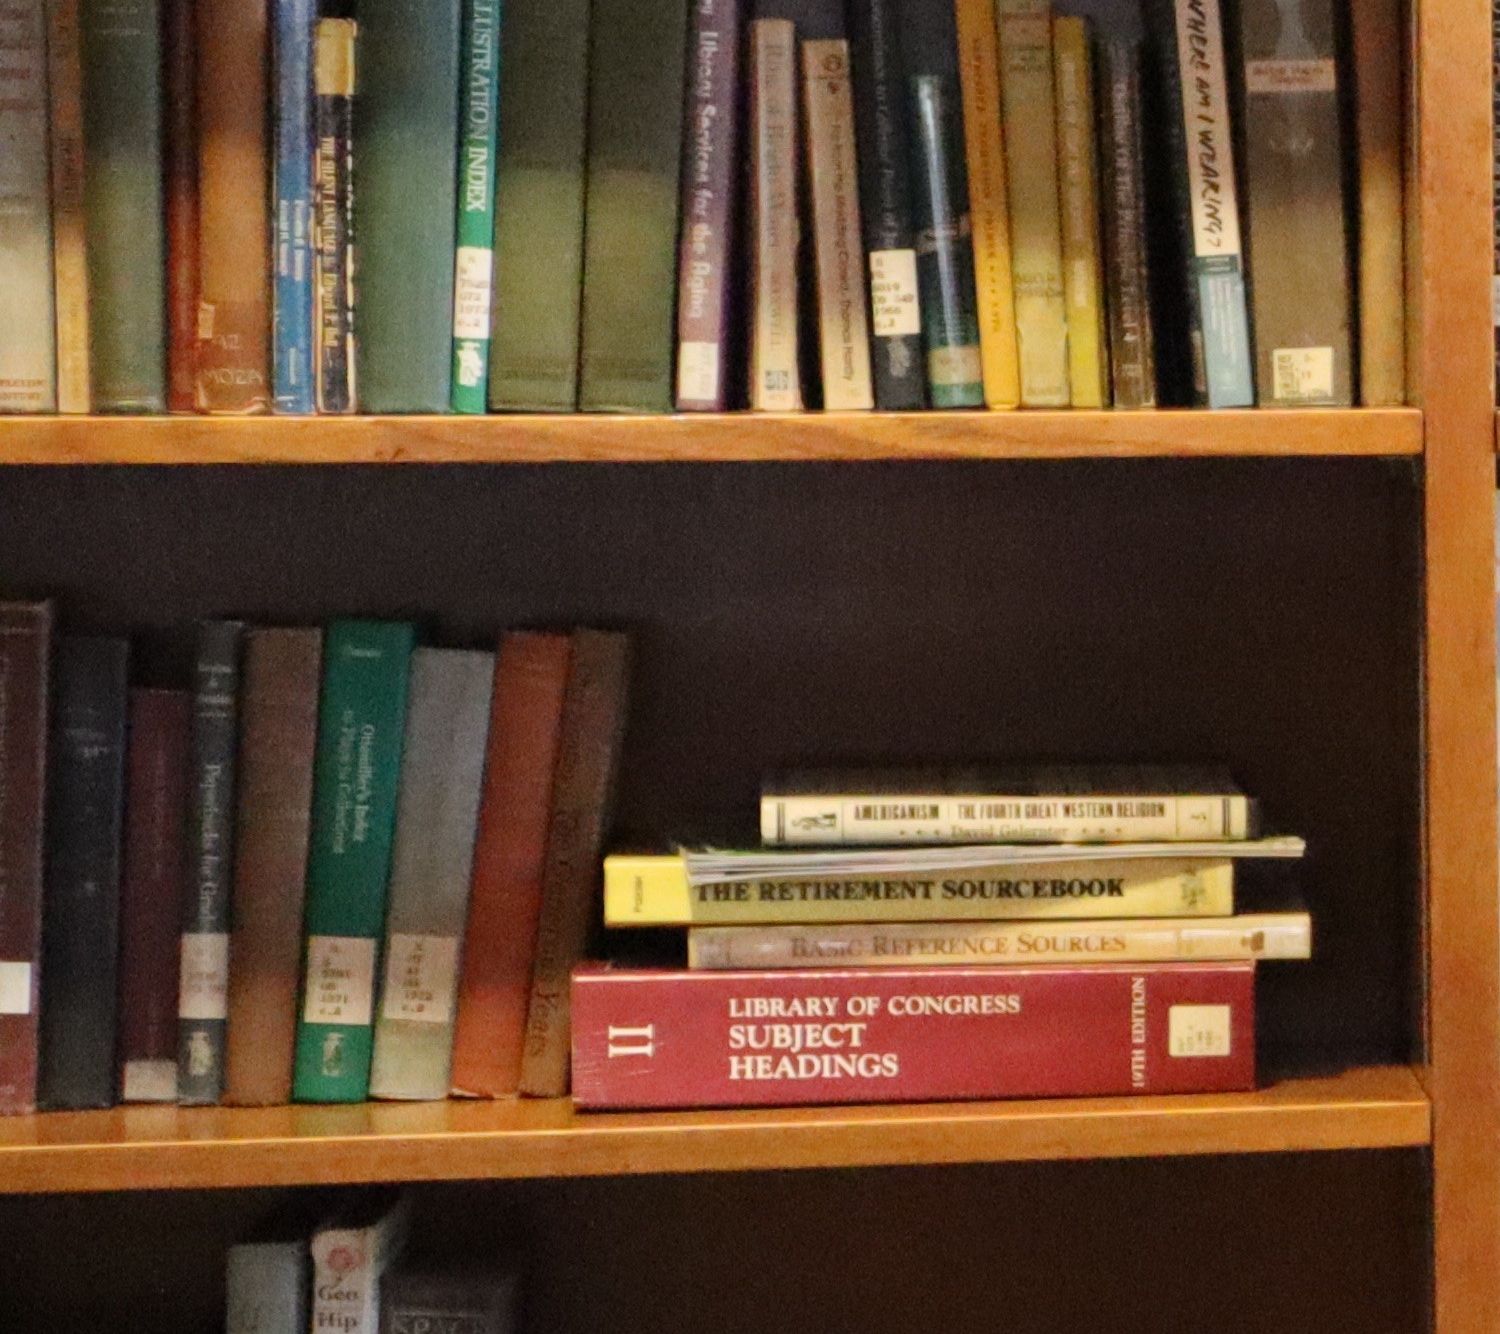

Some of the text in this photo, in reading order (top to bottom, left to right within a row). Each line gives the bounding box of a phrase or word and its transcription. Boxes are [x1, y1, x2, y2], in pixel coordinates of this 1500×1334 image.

[1195, 76, 1212, 109] AM
[694, 103, 717, 183] Services
[465, 145, 489, 213] INDEX
[1194, 127, 1223, 250] WEARING?
[854, 801, 1165, 821] AMERICANISM FOURTH GREAT WESTERN RELIGION
[698, 877, 1124, 904] THE RETIREMENT SOURCEBOOK
[874, 928, 1126, 958] REFERENCE SOURCES
[729, 994, 1021, 1019] LIBRARY OF CONGRESS
[1131, 976, 1146, 1044] EDITION
[608, 1024, 654, 1058] II
[729, 1022, 869, 1050] SUBJECT
[729, 1053, 900, 1081] HEADINGS
[317, 1285, 359, 1303] Geo
[316, 1309, 359, 1334] Hip
